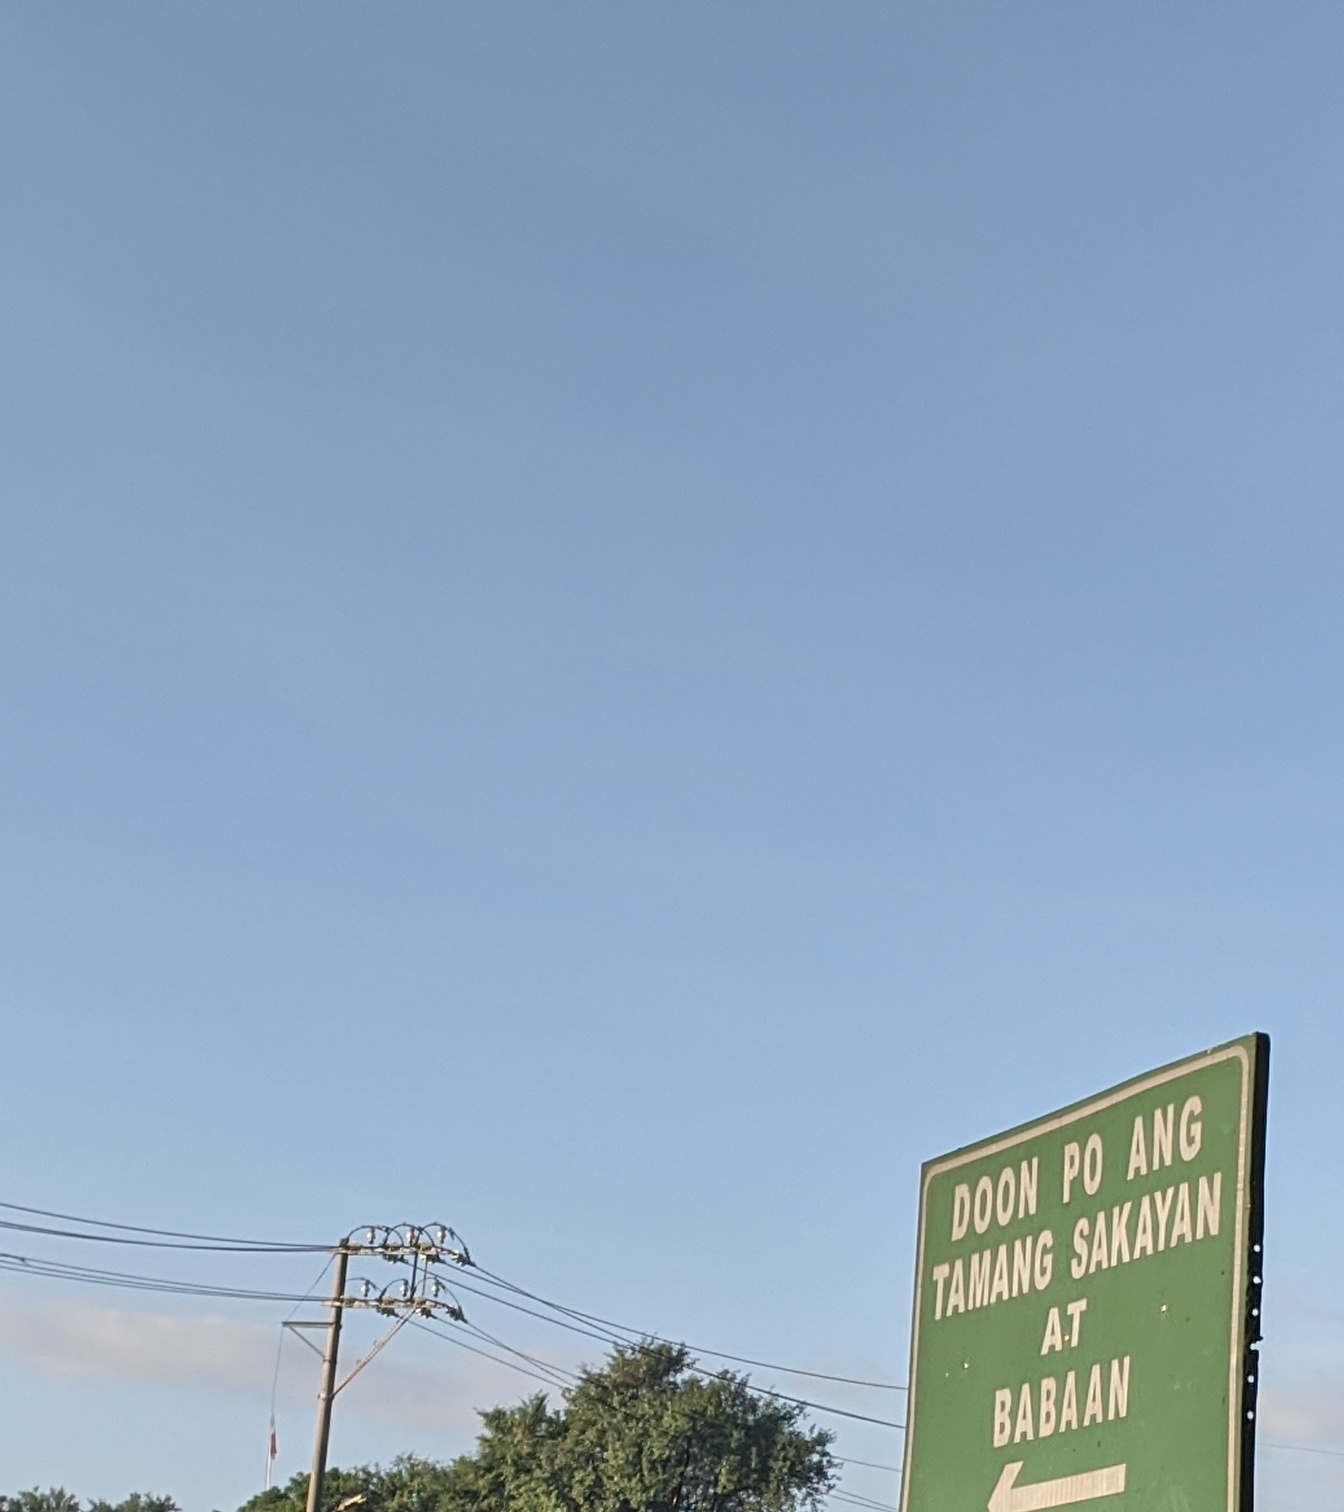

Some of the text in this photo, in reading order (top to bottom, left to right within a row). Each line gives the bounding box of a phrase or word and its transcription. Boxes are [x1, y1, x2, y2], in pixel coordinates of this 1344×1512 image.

[952, 1095, 1202, 1241] DOON PO ANG
[933, 1173, 1222, 1320] TAMANG SAKAYAN
[1041, 1299, 1087, 1355] AT
[993, 1356, 1130, 1448] BABAAN
